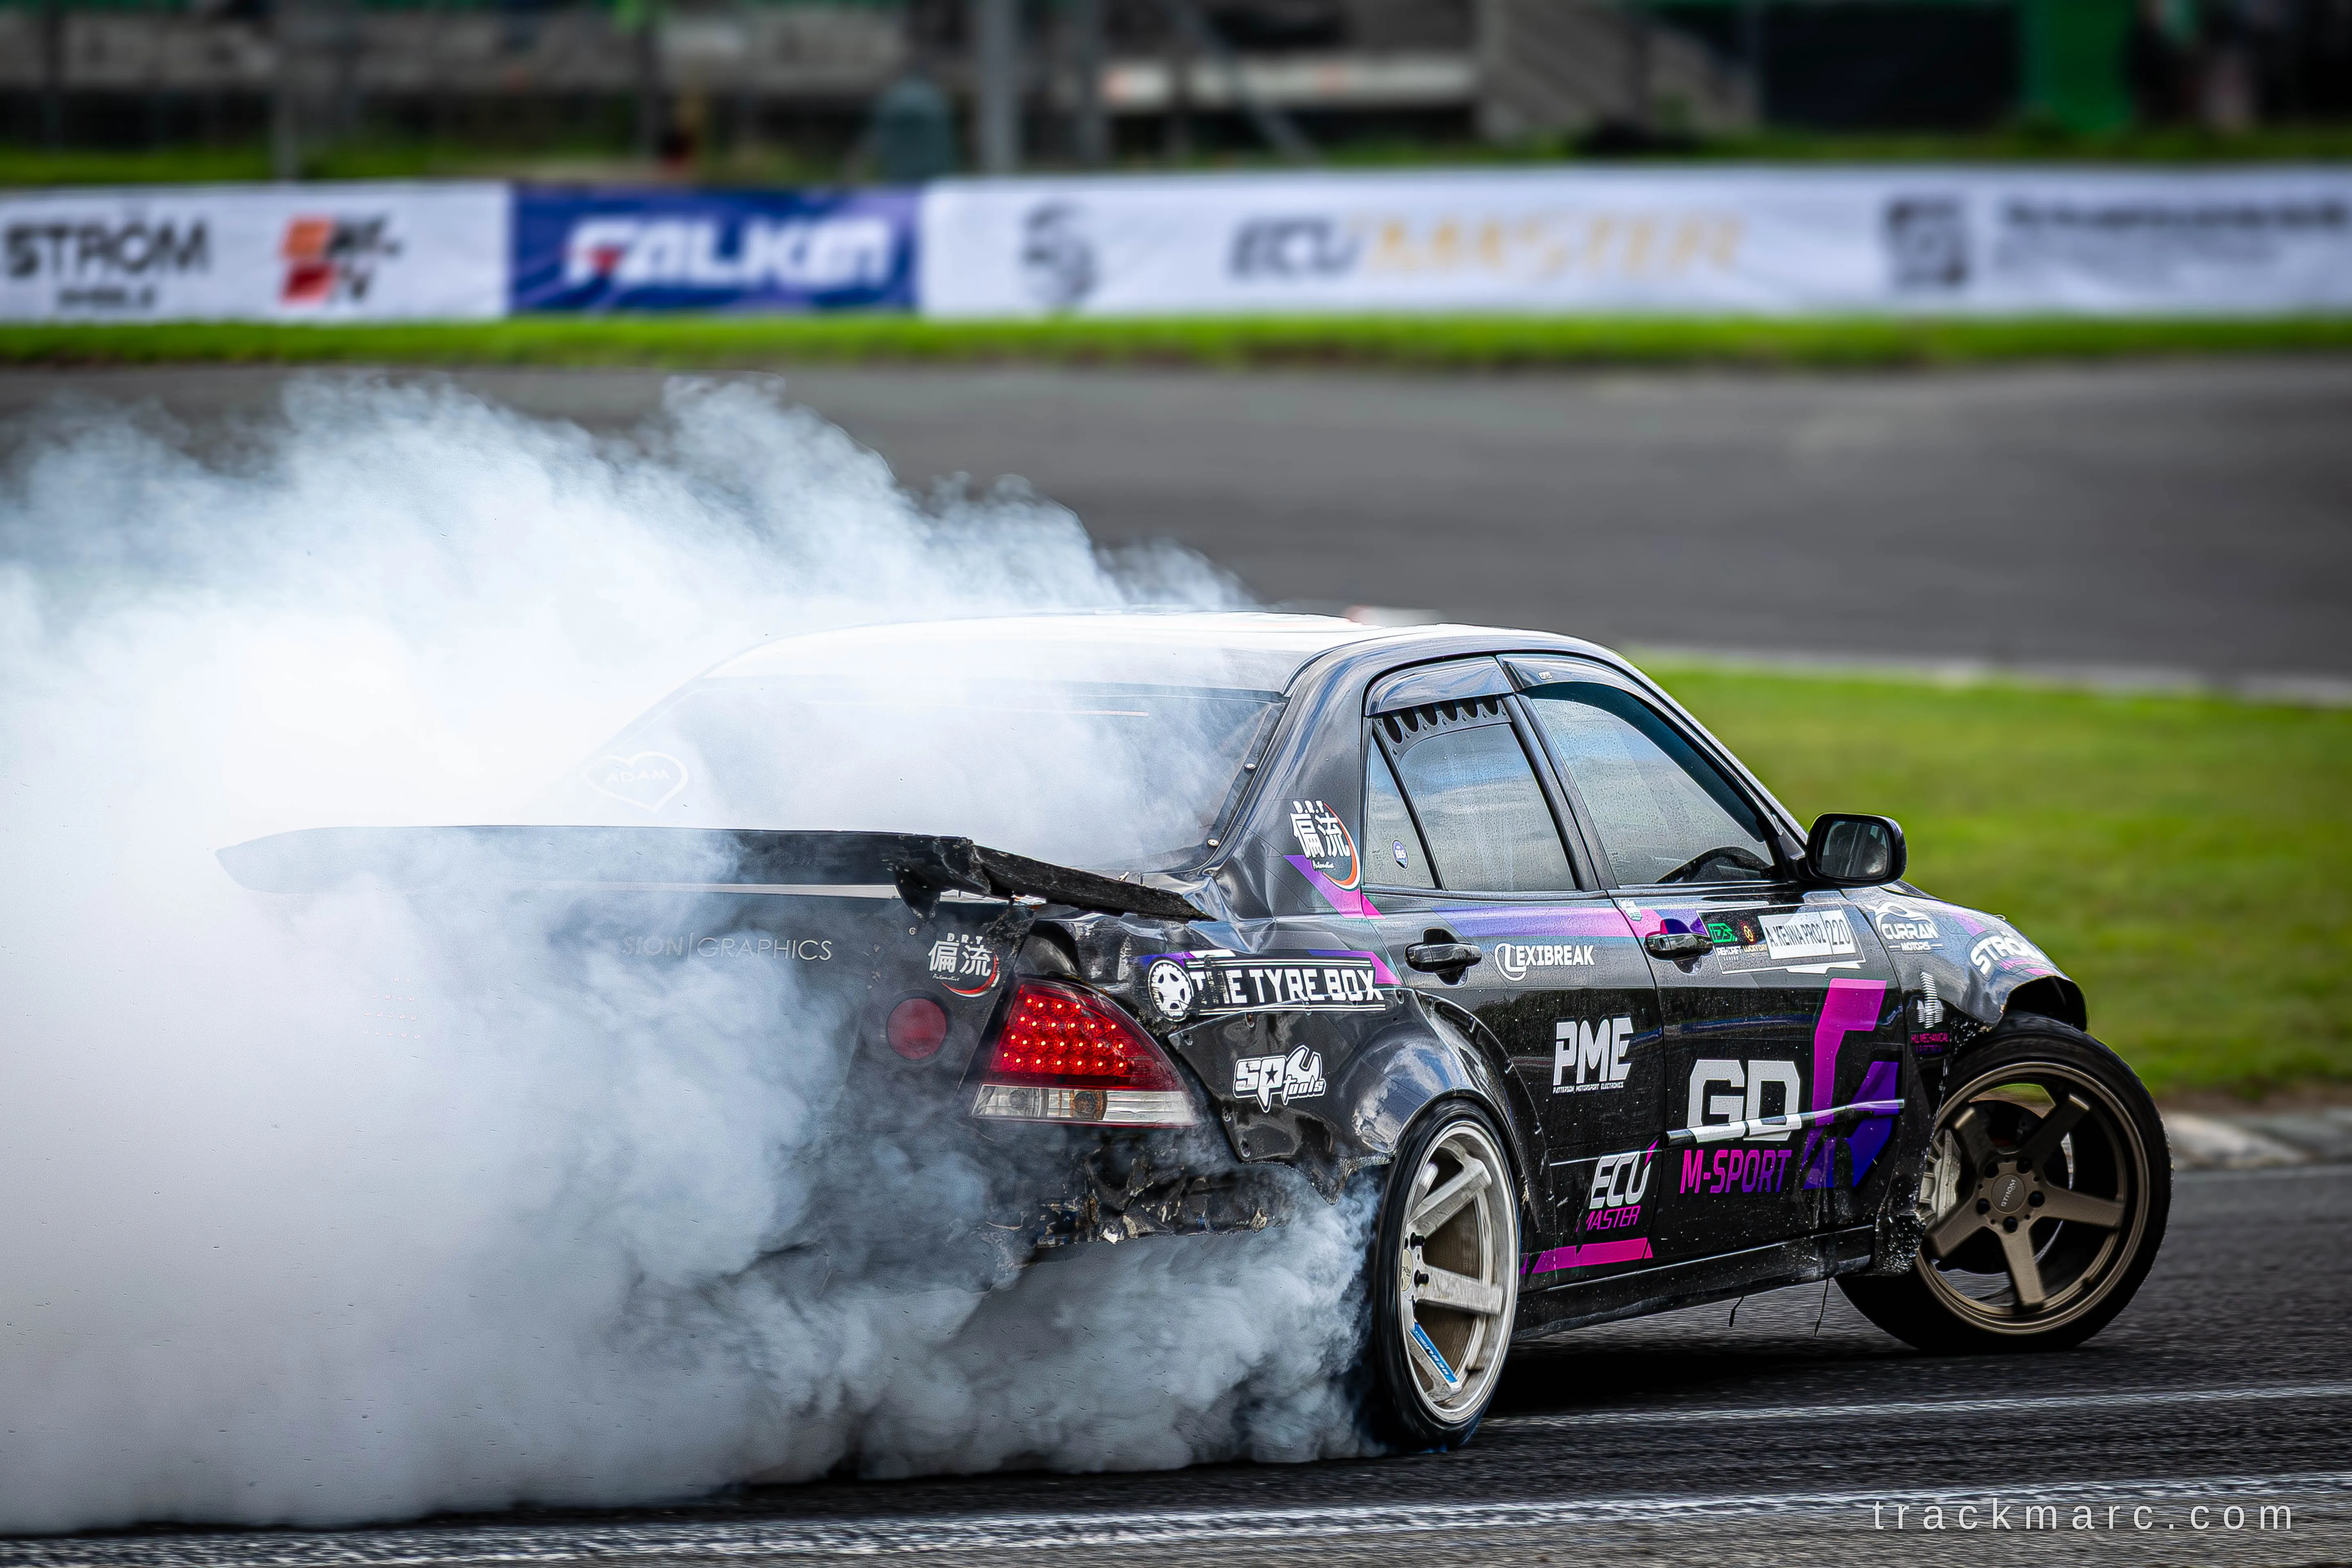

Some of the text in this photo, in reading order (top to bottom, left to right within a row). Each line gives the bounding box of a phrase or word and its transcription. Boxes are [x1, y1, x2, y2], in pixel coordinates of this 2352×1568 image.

[605, 769, 670, 783] ADAM
[1825, 919, 1851, 946] 220
[1881, 923, 1939, 940] CURRAN
[1901, 941, 1932, 951] MOTORS
[928, 940, 993, 977] 偏流
[1495, 943, 1595, 981] LEXIBREAK
[1249, 968, 1326, 1003] TYRE
[1323, 969, 1385, 1001] BOX
[1553, 1017, 1633, 1086] PME
[1281, 1074, 1324, 1102] tools
[1553, 1081, 1624, 1094] PATTERSON MOTORSPORT ELECTRONICS
[1687, 1059, 1802, 1141] GD
[1589, 1148, 1655, 1209] ECU
[1679, 1149, 1792, 1194] M-SPORT
